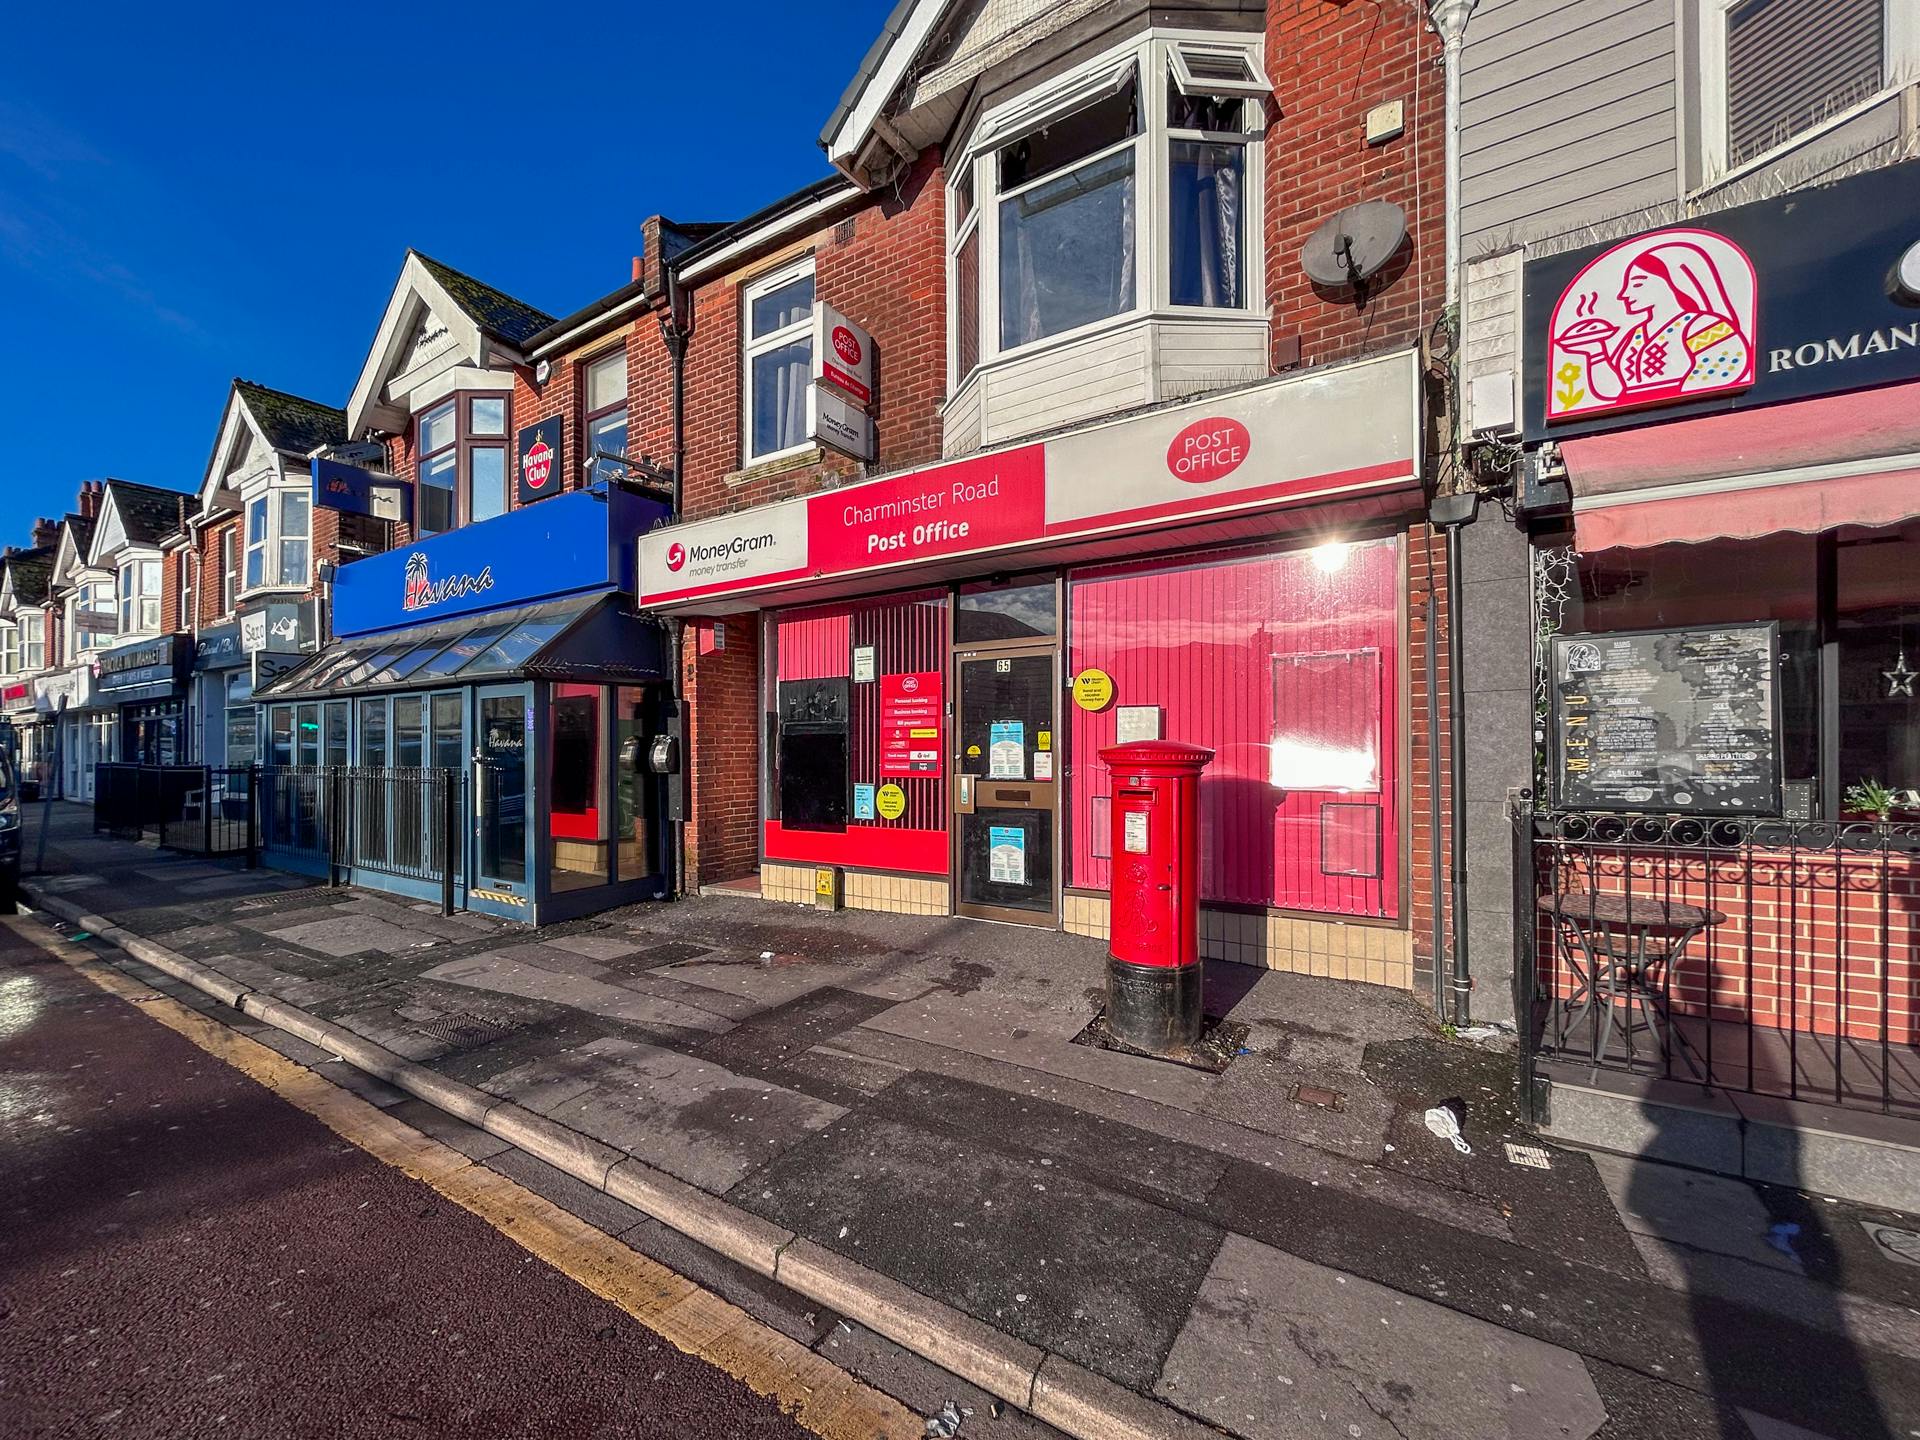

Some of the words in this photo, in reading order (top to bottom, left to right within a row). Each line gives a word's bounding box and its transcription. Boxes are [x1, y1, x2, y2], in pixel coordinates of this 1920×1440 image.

[834, 339, 859, 361] OFFICE
[838, 331, 855, 349] POST
[1768, 322, 1920, 373] ROMAN
[822, 412, 859, 439] MoneyGram
[1185, 428, 1234, 454] POST
[522, 447, 554, 469] Havana
[1176, 446, 1241, 473] OFFICE
[528, 464, 547, 482] Club
[843, 491, 946, 526] Charminster
[951, 474, 999, 505] Road
[867, 530, 907, 554] Post
[912, 520, 970, 545] Office
[689, 564, 715, 577] money
[716, 557, 748, 573] transfer
[402, 565, 495, 611] Havana
[488, 735, 523, 748] Havana
[1564, 694, 1590, 772] MENU
